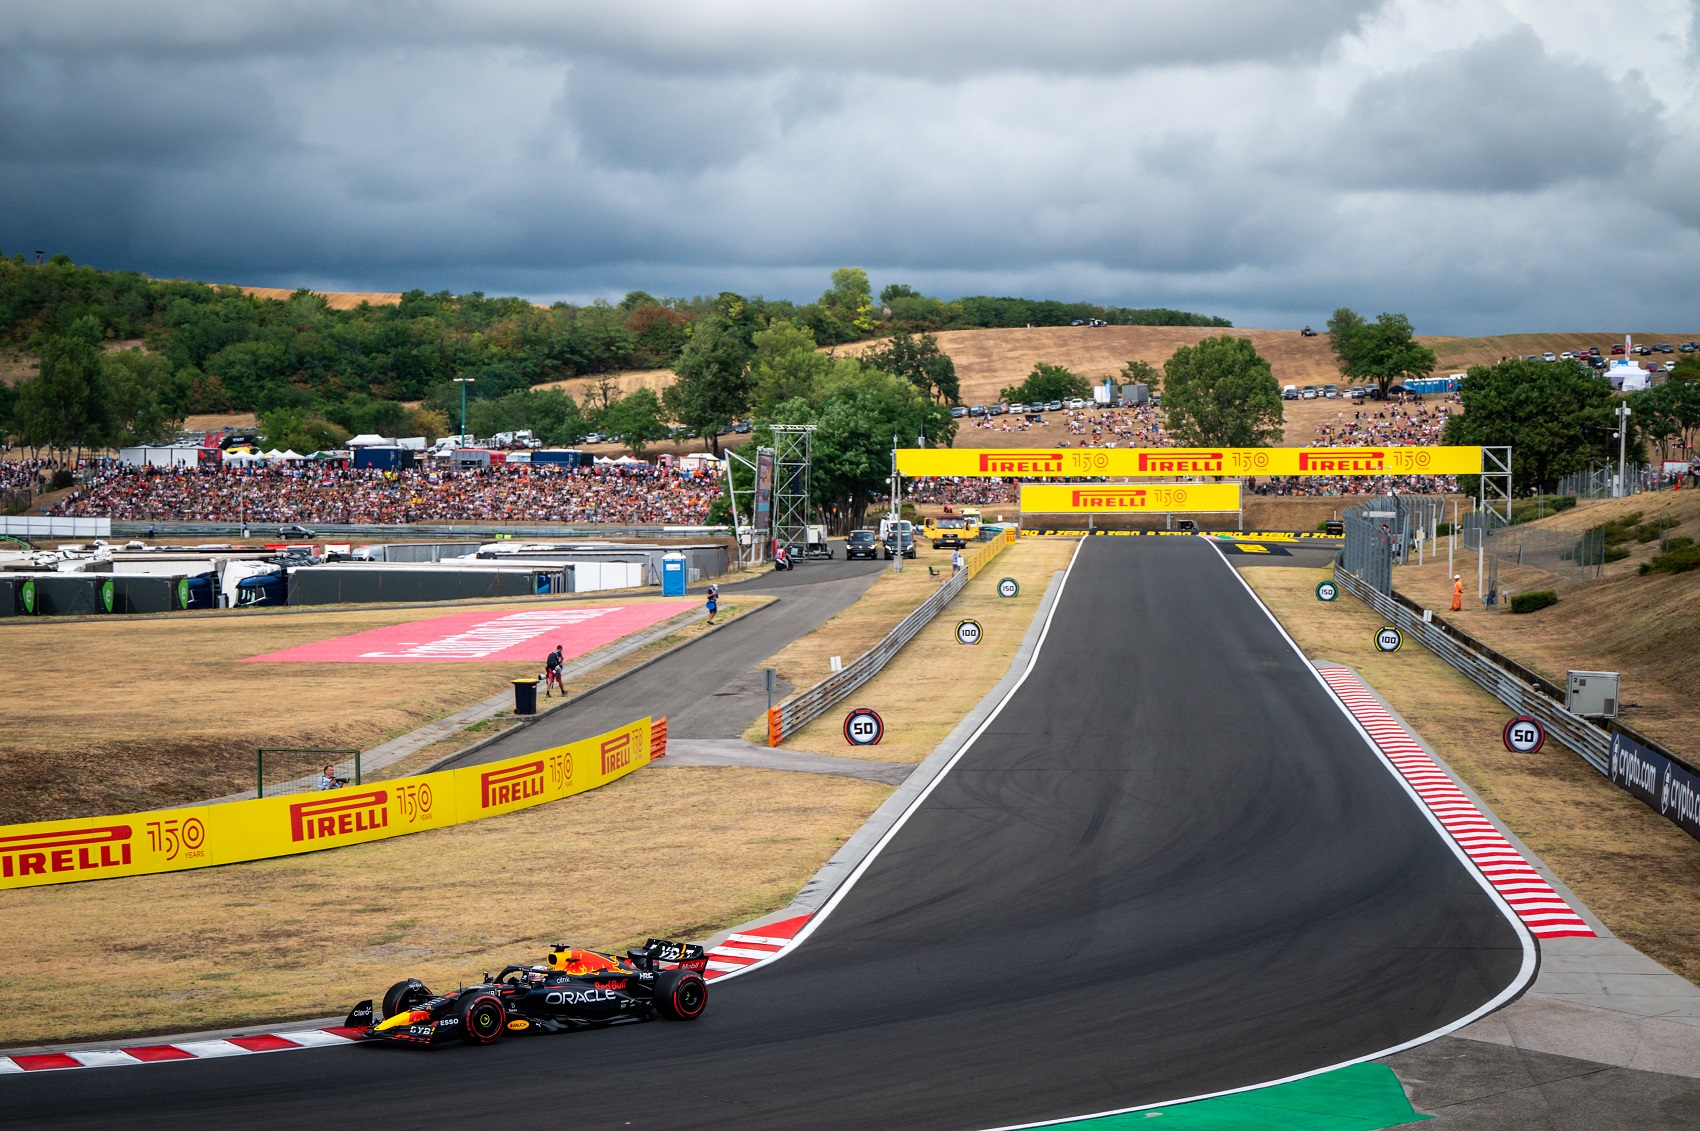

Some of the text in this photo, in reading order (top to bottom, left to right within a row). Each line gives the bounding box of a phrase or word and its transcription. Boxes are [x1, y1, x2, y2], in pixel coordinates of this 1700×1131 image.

[979, 453, 1108, 472] PIRELLI 150
[1139, 452, 1269, 471] PIRELLI 150
[1299, 451, 1430, 470] PIRELLI 150
[1072, 489, 1186, 507] PIRELLI 150
[854, 723, 873, 734] 50
[1514, 730, 1534, 742] 50
[601, 733, 630, 775] PIRELLI
[481, 752, 573, 808] PIRELLI 150
[1619, 748, 1656, 795] crypto.com
[290, 783, 432, 842] PIRELLI 150
[146, 818, 205, 861] 150
[184, 850, 205, 859] YEARS
[594, 978, 628, 990] Red Bull
[545, 990, 616, 1004] ORACLE
